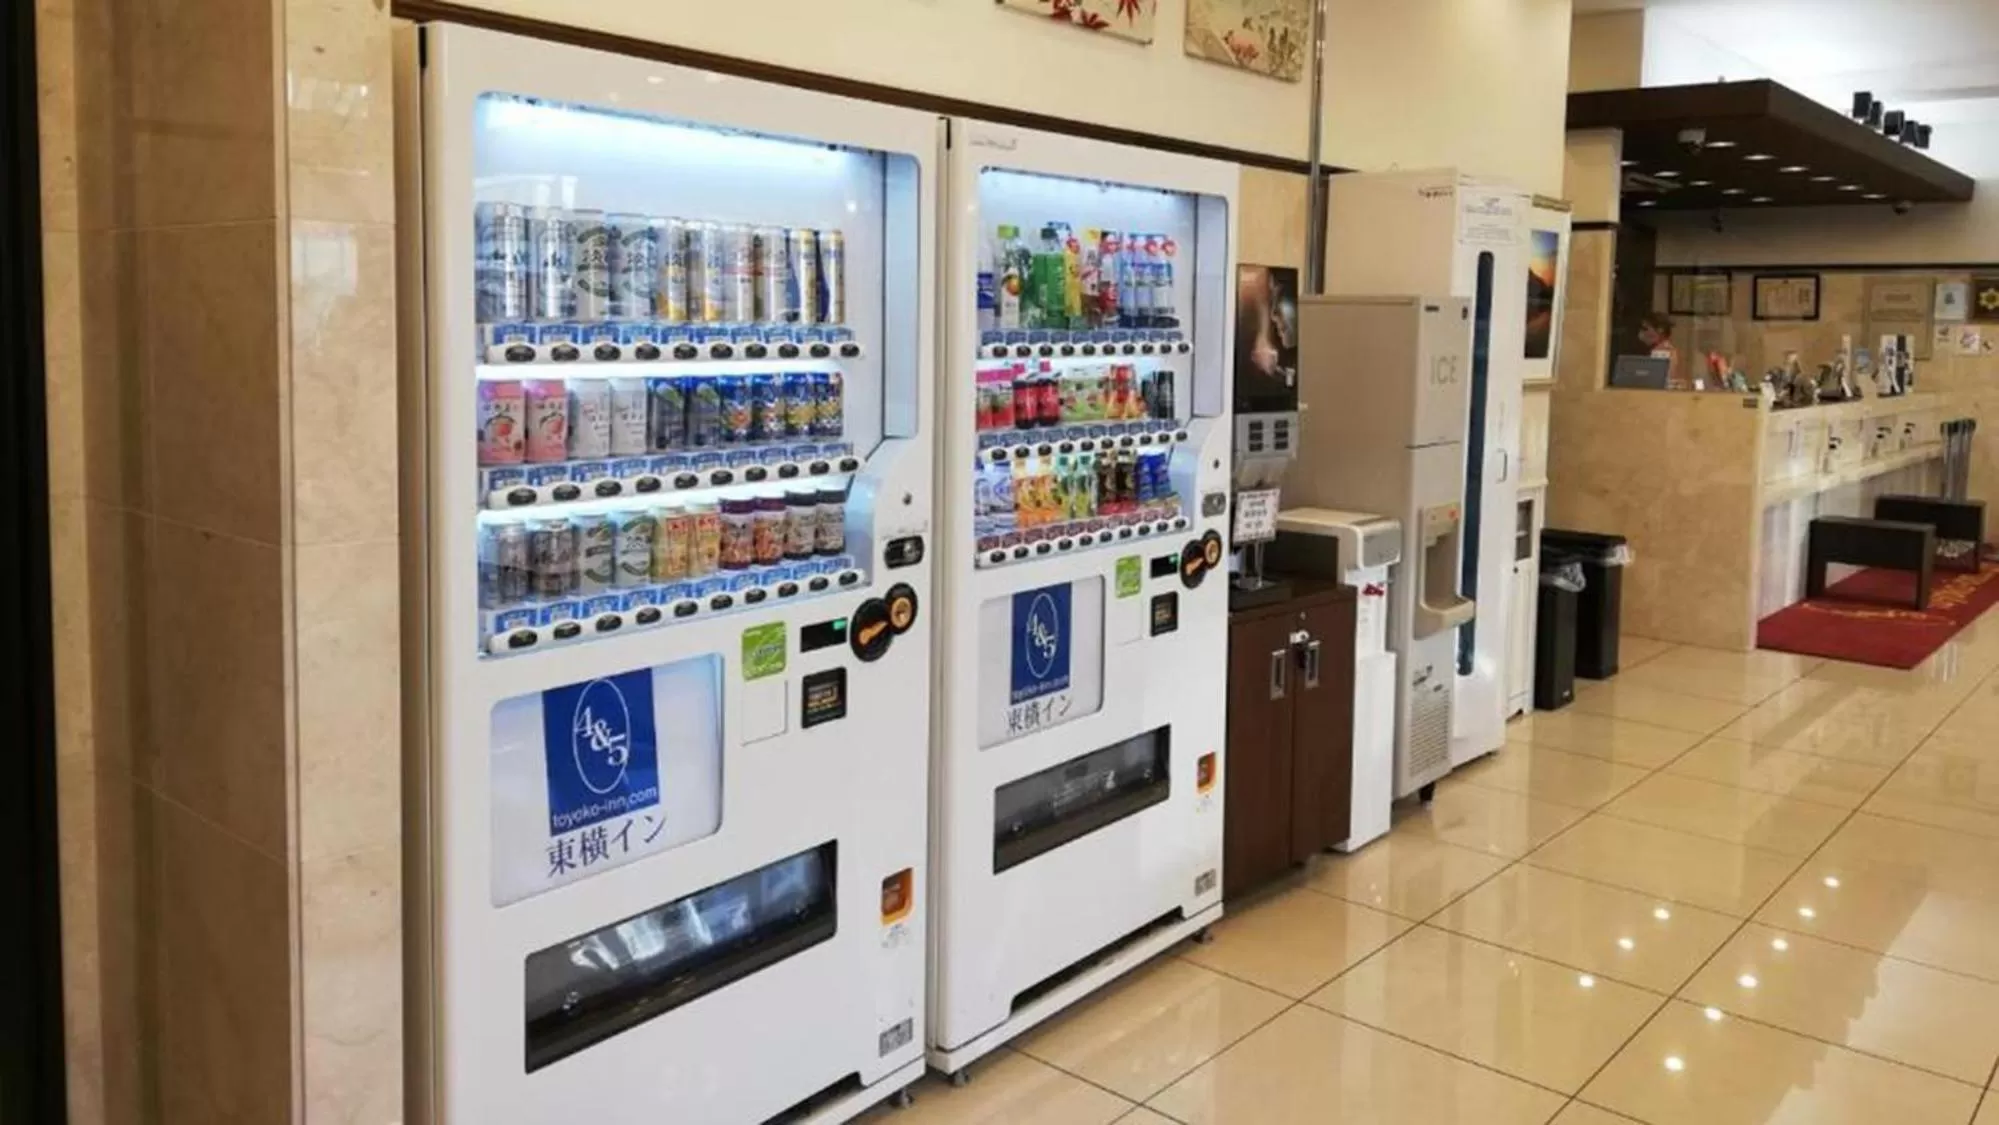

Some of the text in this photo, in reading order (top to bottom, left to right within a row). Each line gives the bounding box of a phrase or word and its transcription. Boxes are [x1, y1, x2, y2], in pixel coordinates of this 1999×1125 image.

[1430, 354, 1459, 385] ICE
[1006, 695, 1073, 735] 東横イン
[553, 786, 658, 829] toyoko-inn.com
[546, 813, 668, 878] 東横イン
